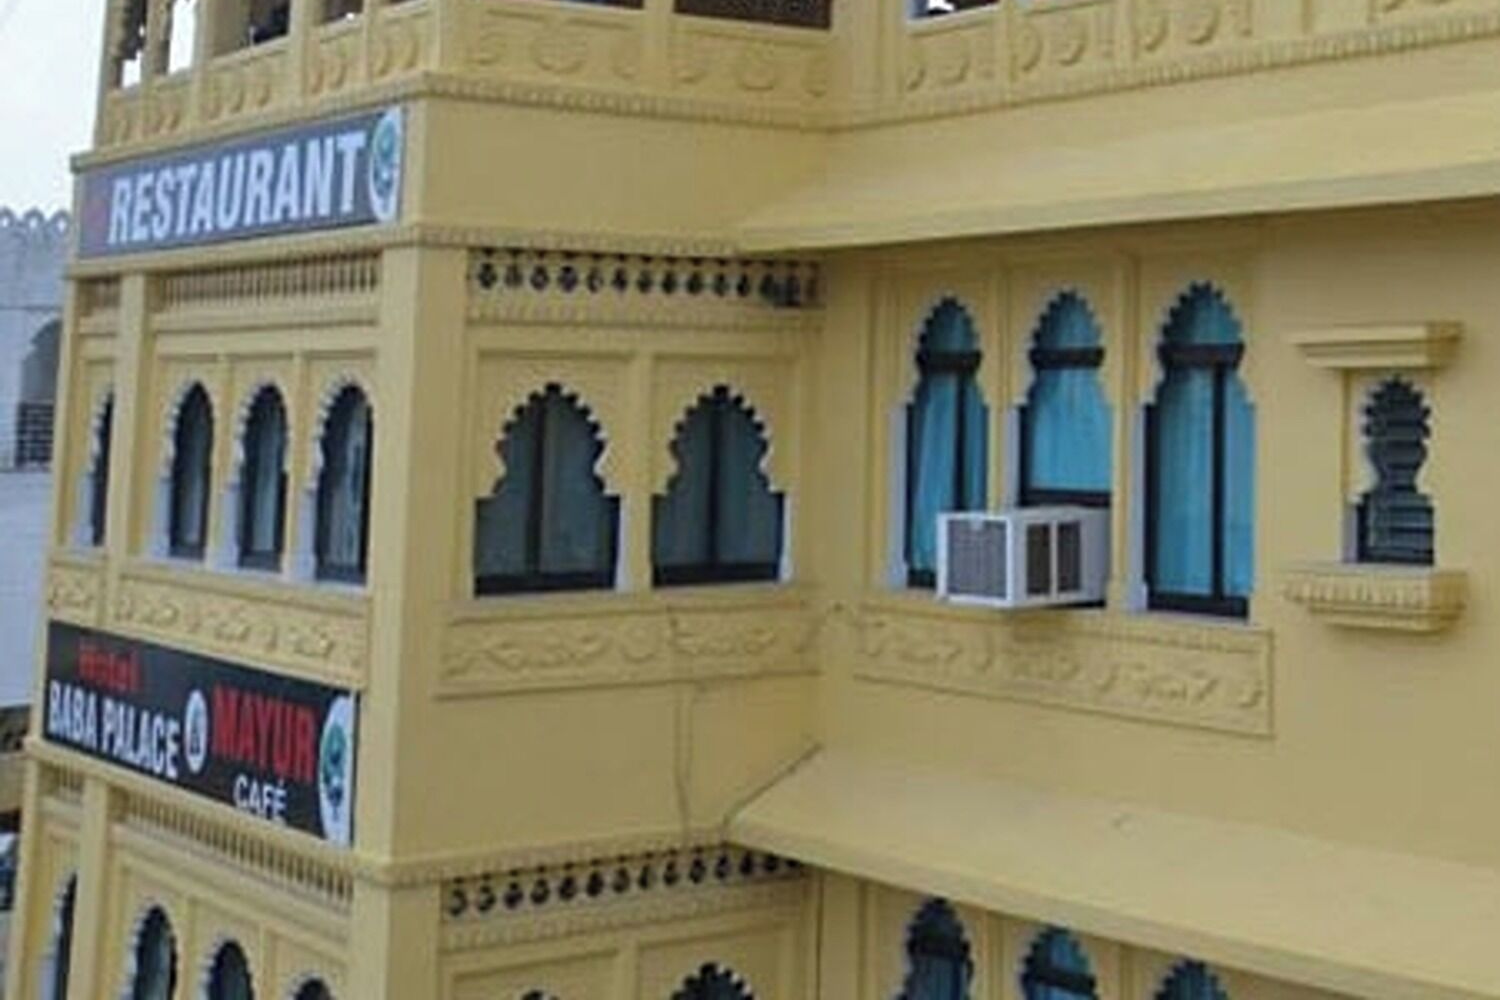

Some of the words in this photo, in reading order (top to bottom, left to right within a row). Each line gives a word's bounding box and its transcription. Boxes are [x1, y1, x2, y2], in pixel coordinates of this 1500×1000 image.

[108, 130, 366, 245] RESTAURANT
[49, 680, 97, 750] BABA
[102, 698, 179, 779] PALACE
[212, 680, 317, 784] MAYUR
[234, 774, 288, 824] CAFÉ
